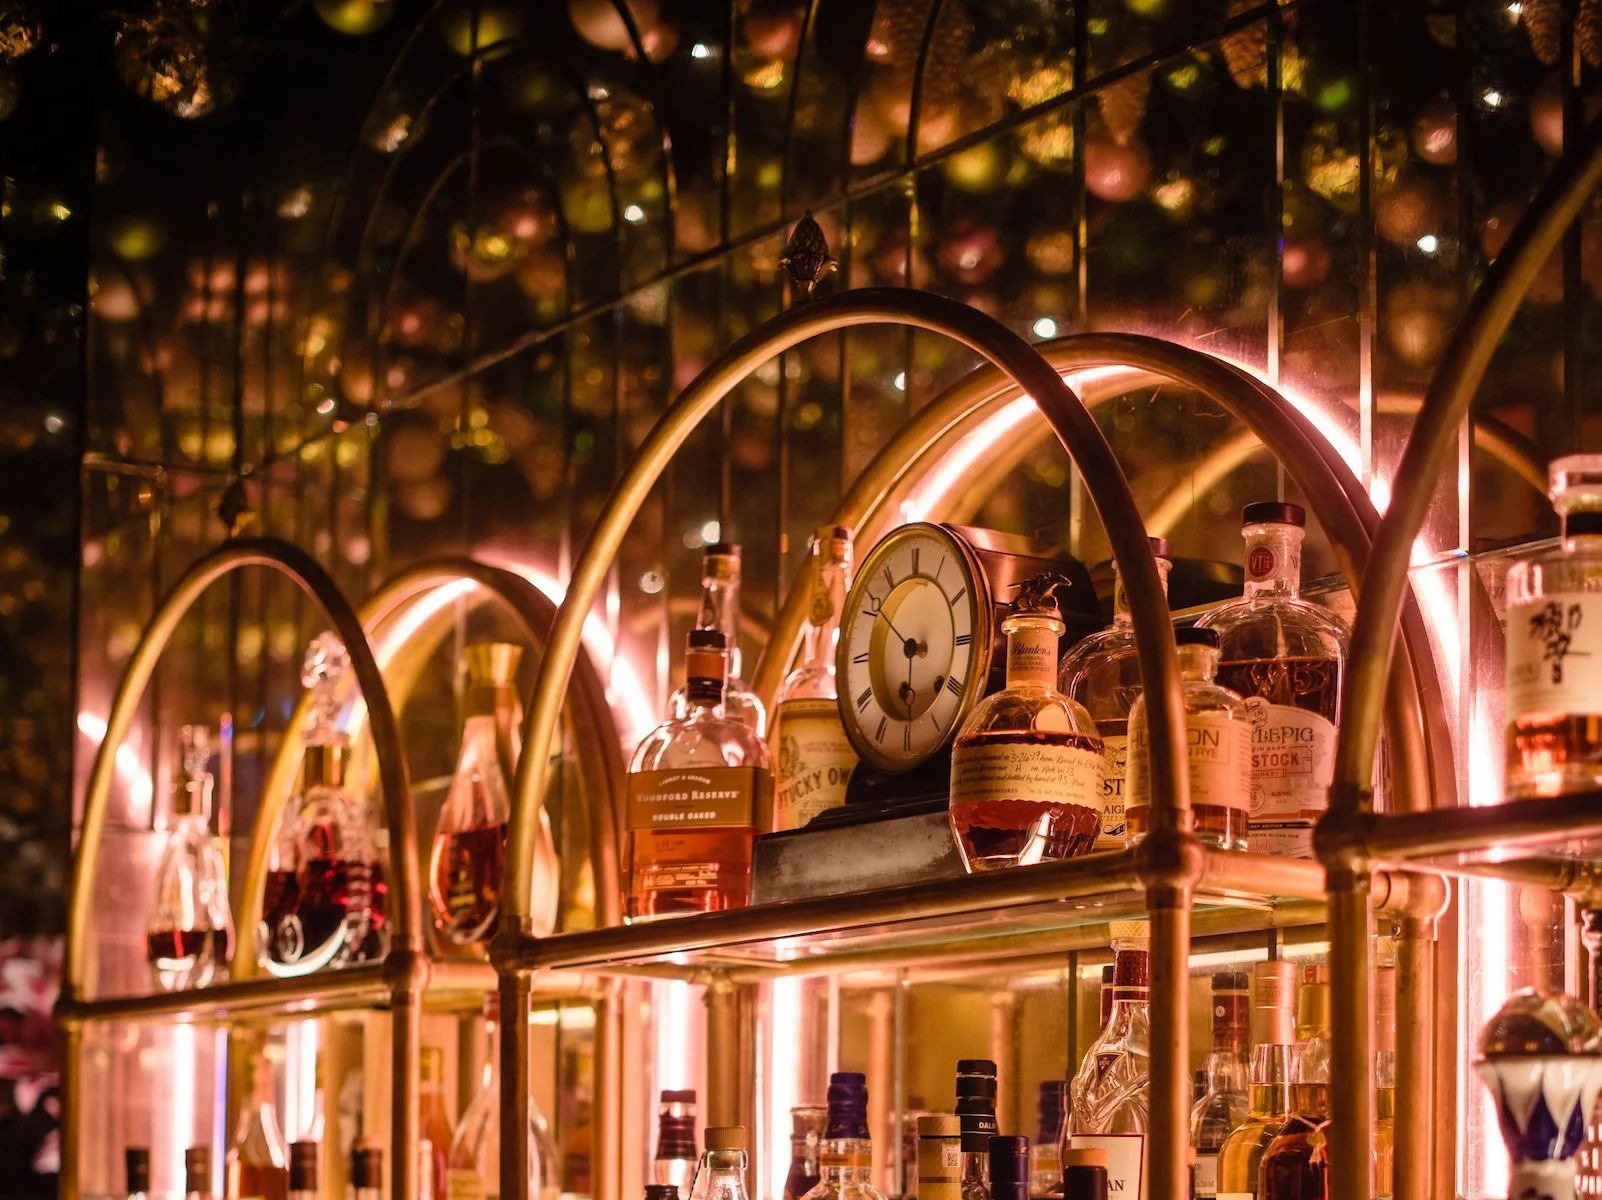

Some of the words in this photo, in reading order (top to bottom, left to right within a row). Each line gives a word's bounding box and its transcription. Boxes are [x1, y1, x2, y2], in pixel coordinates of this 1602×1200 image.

[1013, 642, 1051, 656] Blanton's
[1251, 752, 1300, 768] STOCK
[652, 812, 685, 822] DOUBLE
[687, 811, 716, 820] OAKED
